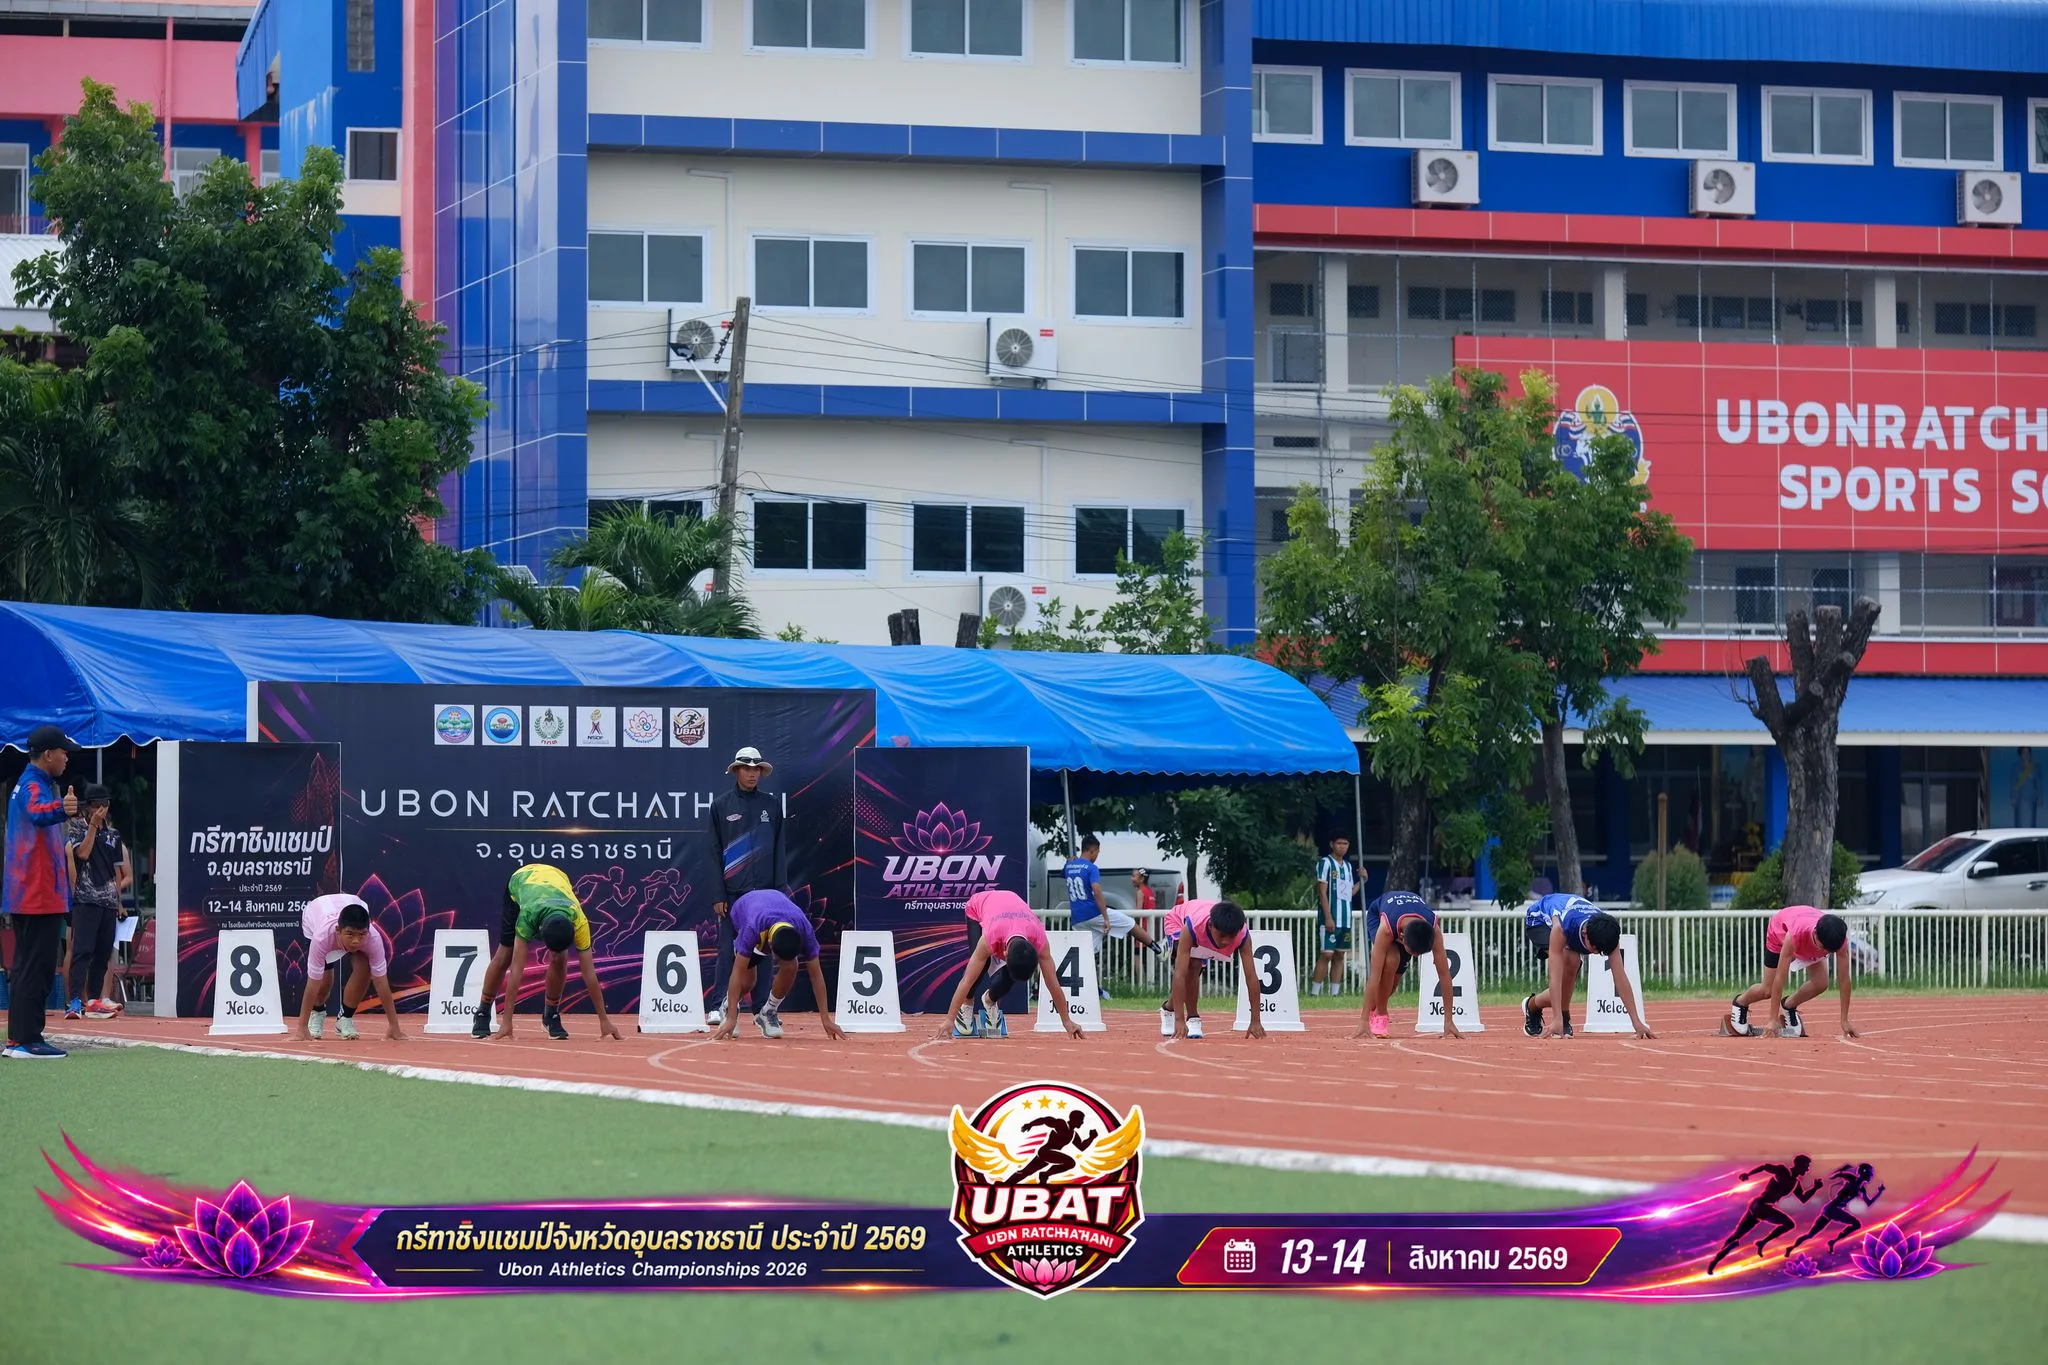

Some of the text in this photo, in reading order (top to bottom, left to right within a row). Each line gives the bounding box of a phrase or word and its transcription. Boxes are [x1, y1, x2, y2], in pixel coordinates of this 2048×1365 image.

[1779, 464, 2048, 514] SPORTS S
[676, 727, 704, 736] UBAT
[360, 788, 787, 819] UBON RATCHATHI
[883, 855, 1006, 882] UBON
[239, 884, 263, 892] ประจำปี
[1066, 876, 1087, 902] 30
[208, 900, 312, 913] 12-14 สิงหาคม 256
[229, 944, 263, 997] 8
[444, 945, 478, 998] 7
[655, 943, 688, 995] 6
[851, 945, 883, 997] 5
[1056, 945, 1084, 997] 4
[1254, 945, 1283, 996] 3
[1433, 948, 1463, 997] 2
[226, 1000, 265, 1016] Nelco
[651, 998, 689, 1014] Nelco
[847, 999, 884, 1016] Nelco
[1429, 1001, 1464, 1016] Neco
